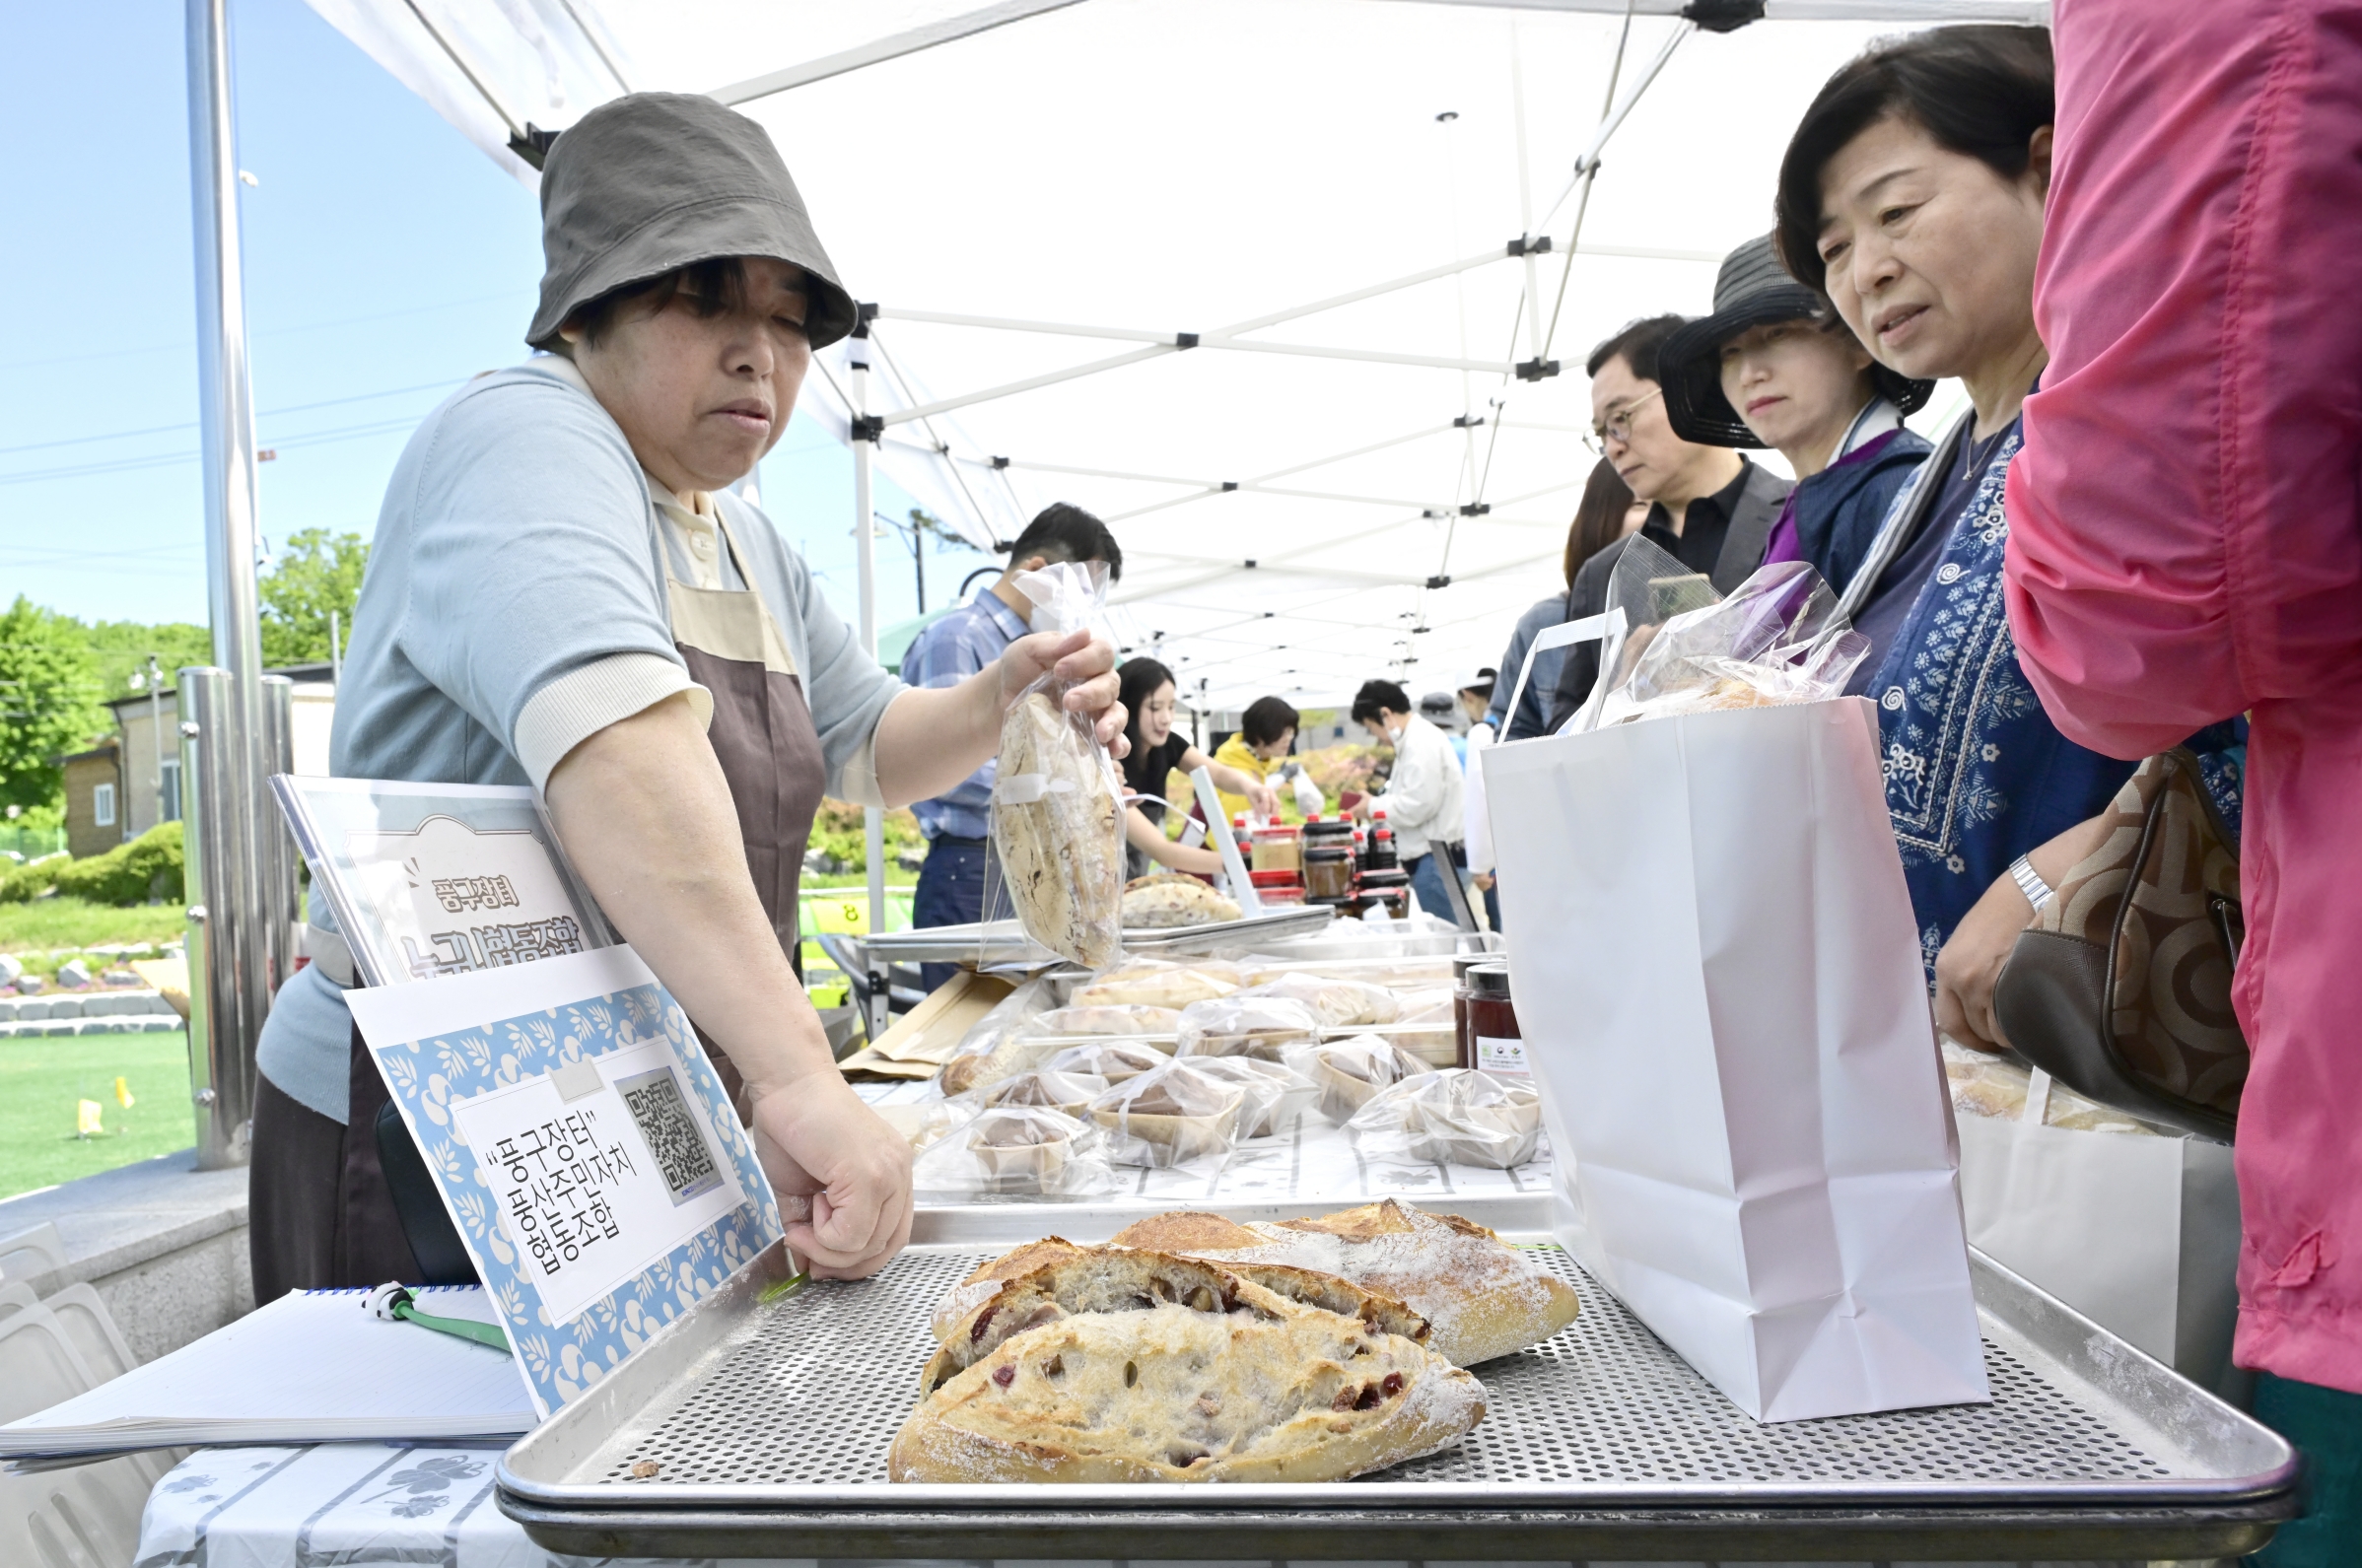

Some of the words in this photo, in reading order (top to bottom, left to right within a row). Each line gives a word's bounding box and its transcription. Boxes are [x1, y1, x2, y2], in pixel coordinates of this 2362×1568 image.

[432, 874, 520, 913] 풍구장터
[485, 1110, 597, 1184] “풍구장터”
[507, 1140, 638, 1233] 풍산주민자치
[525, 1195, 620, 1276] 협동조합
